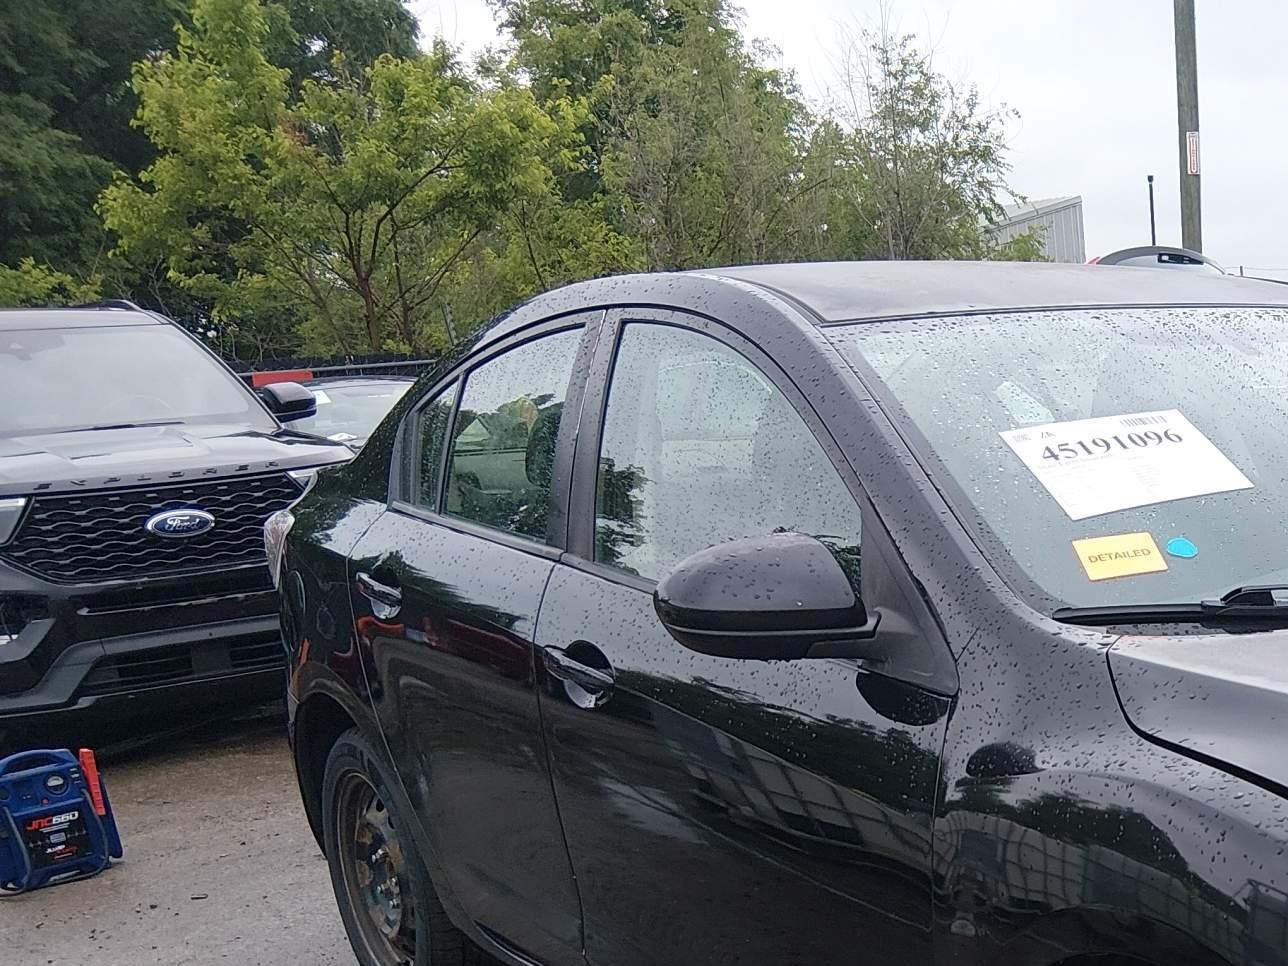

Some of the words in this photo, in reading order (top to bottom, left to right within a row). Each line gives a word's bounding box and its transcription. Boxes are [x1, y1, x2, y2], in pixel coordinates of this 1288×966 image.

[1041, 428, 1183, 461] 45191096
[165, 516, 201, 531] Ford
[1087, 548, 1152, 564] DETAILED
